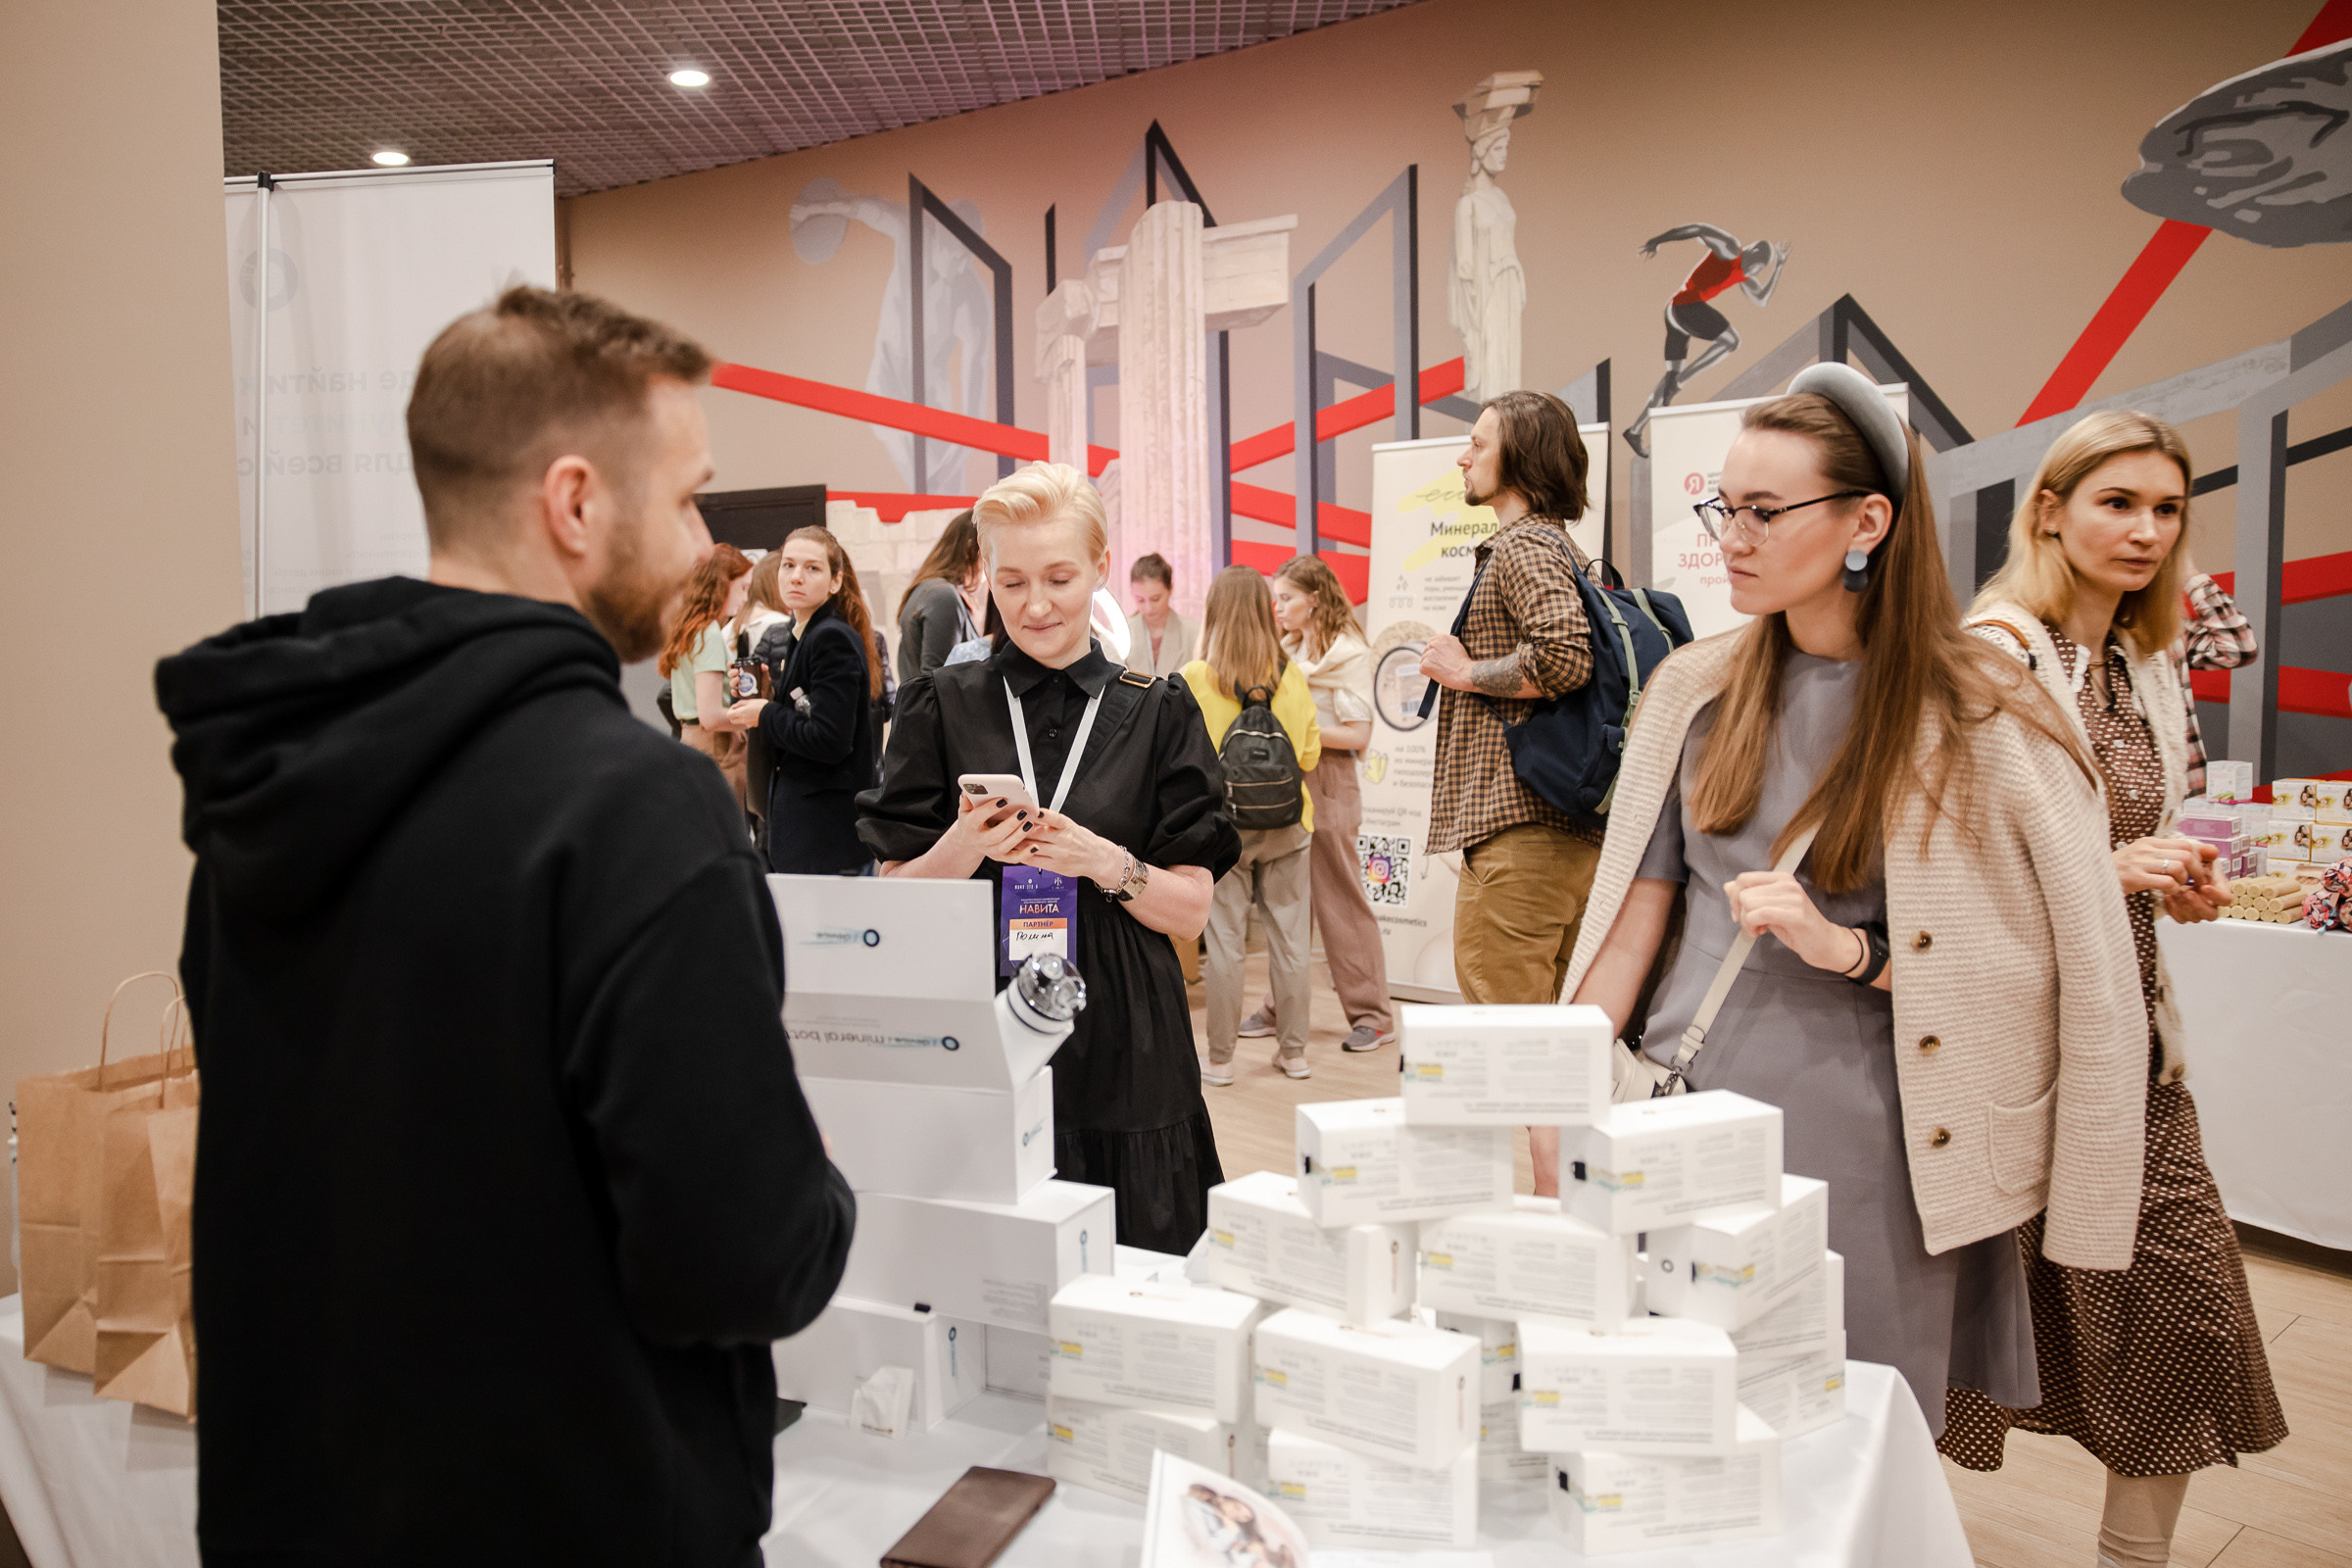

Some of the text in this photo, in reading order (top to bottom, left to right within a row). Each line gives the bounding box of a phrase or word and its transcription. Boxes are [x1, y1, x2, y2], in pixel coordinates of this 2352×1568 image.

[1430, 521, 1497, 538] Минерал
[1441, 546, 1476, 559] косм
[1678, 553, 1723, 570] ЗДОР
[1019, 903, 1060, 914] НАВИТА
